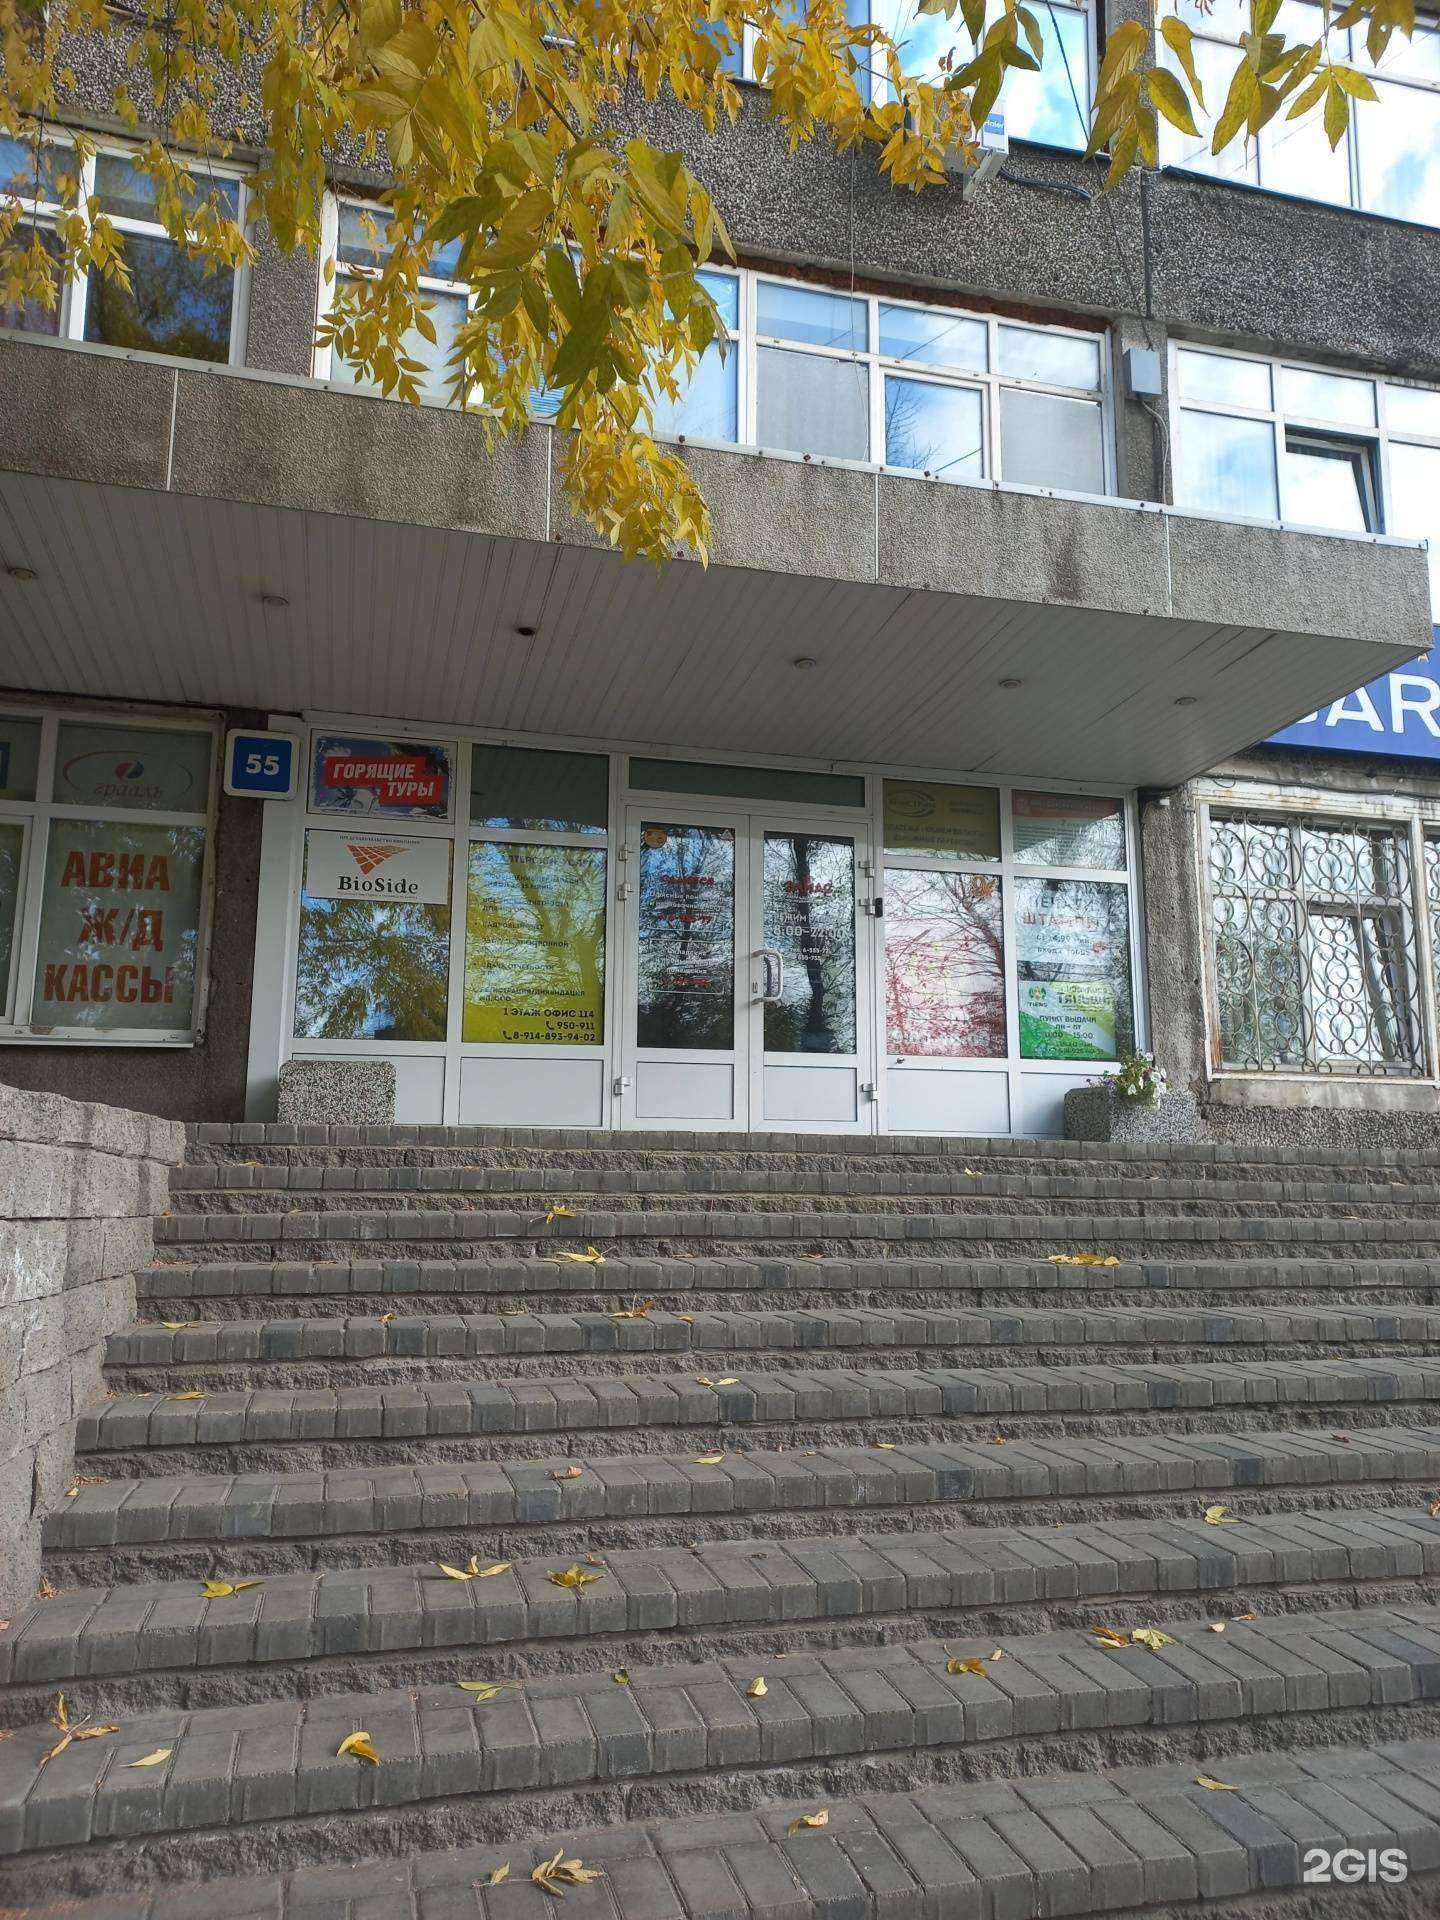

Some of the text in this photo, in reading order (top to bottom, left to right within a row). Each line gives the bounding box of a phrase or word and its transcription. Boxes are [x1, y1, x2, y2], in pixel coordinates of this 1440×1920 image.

[1296, 672, 1440, 738] AR
[246, 753, 280, 776] 55
[333, 763, 416, 780] ГОРЯЩИЕ
[387, 781, 435, 797] ТУРЫ
[61, 851, 171, 891] АВИА
[337, 876, 419, 895] BioSide
[78, 908, 164, 951] Ж/Д
[43, 963, 175, 1003] КАССЫ
[503, 1007, 594, 1018] 1 ЭТАЖ ОФИС 114
[557, 1021, 595, 1030] 950-911
[513, 1031, 595, 1042] 8-914-893-94-02
